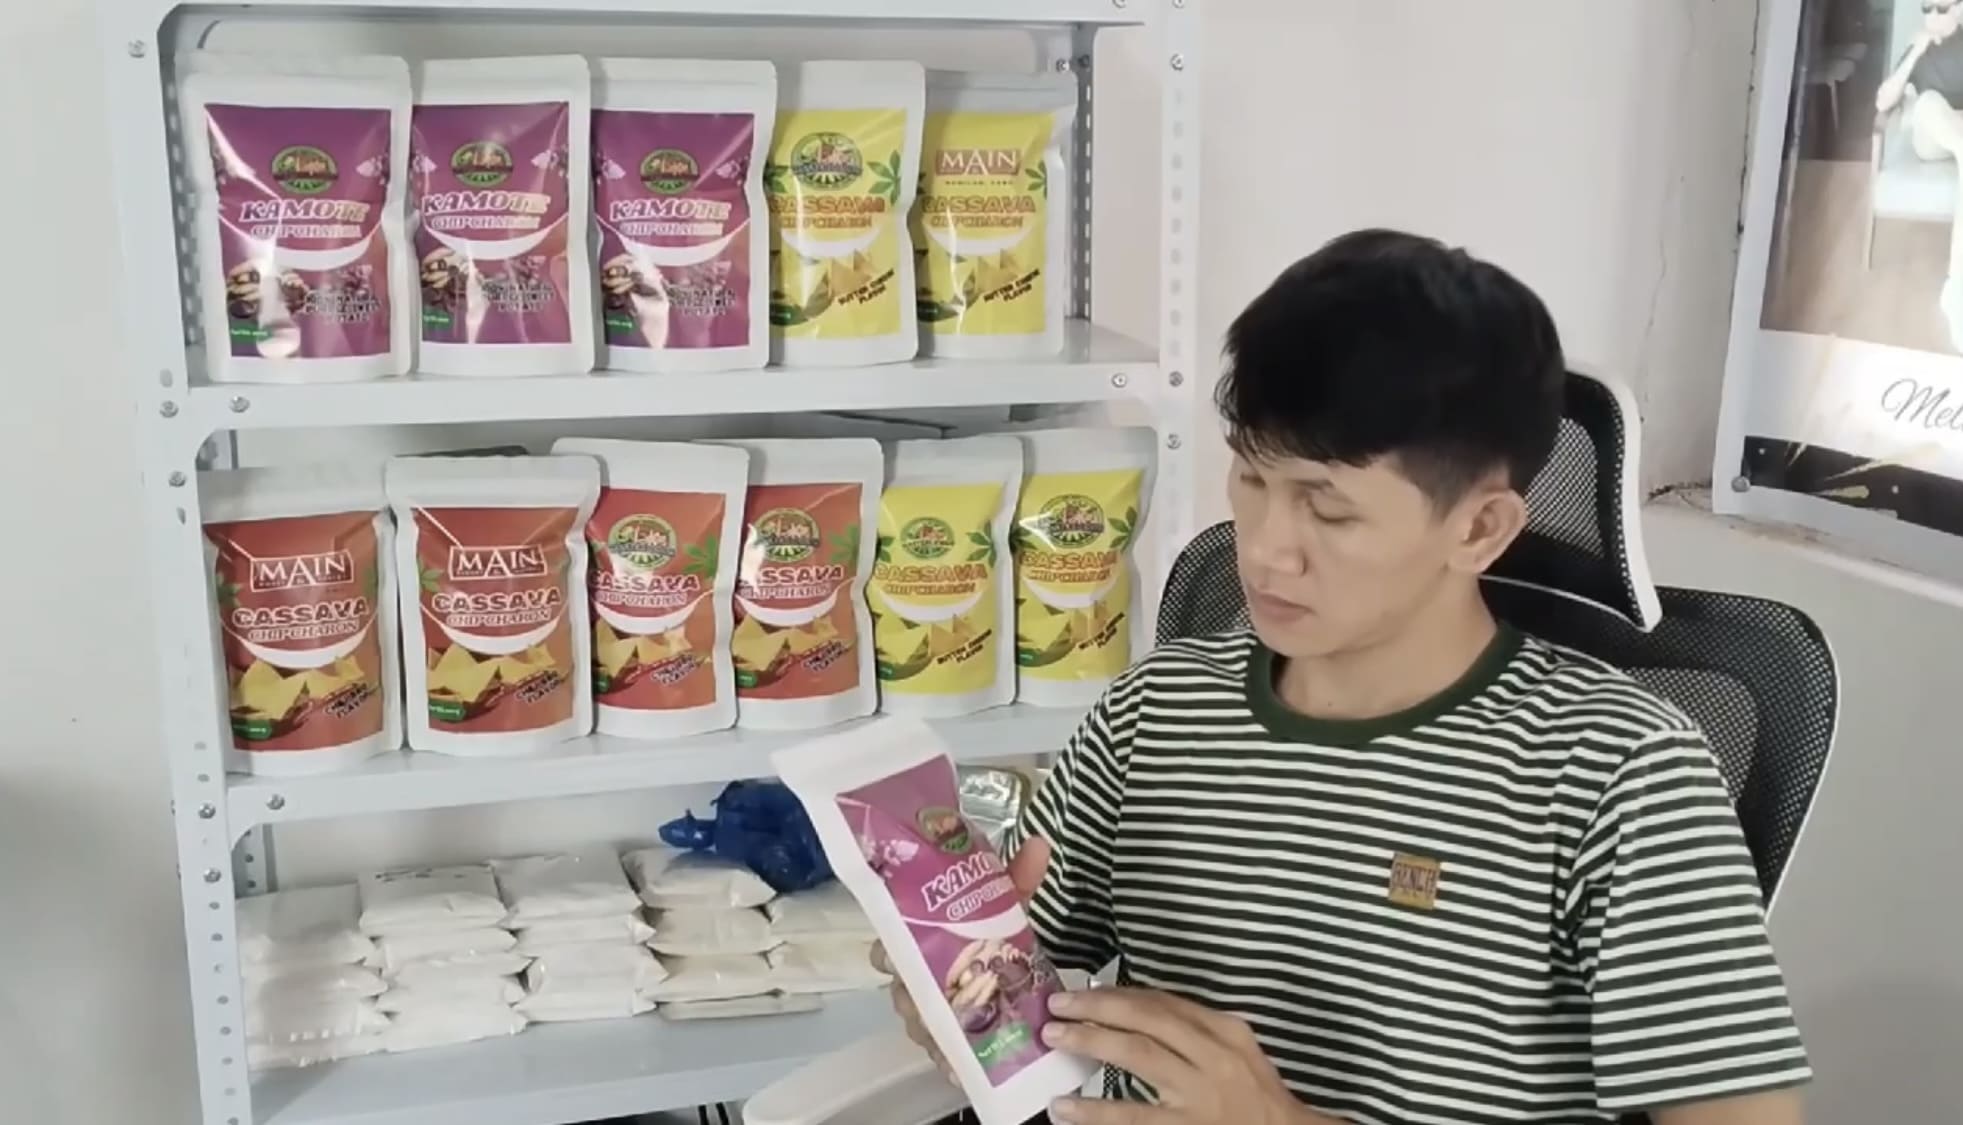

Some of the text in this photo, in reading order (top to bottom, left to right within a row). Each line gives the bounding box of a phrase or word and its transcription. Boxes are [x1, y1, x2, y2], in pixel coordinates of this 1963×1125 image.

[942, 148, 1016, 176] MAIN
[239, 198, 370, 223] KAMOTE
[260, 553, 345, 589] MAIN
[458, 547, 539, 577] MAIN
[739, 565, 844, 587] SSAVA
[231, 596, 370, 628] CASSAVA
[431, 586, 562, 613] CASSAVA
